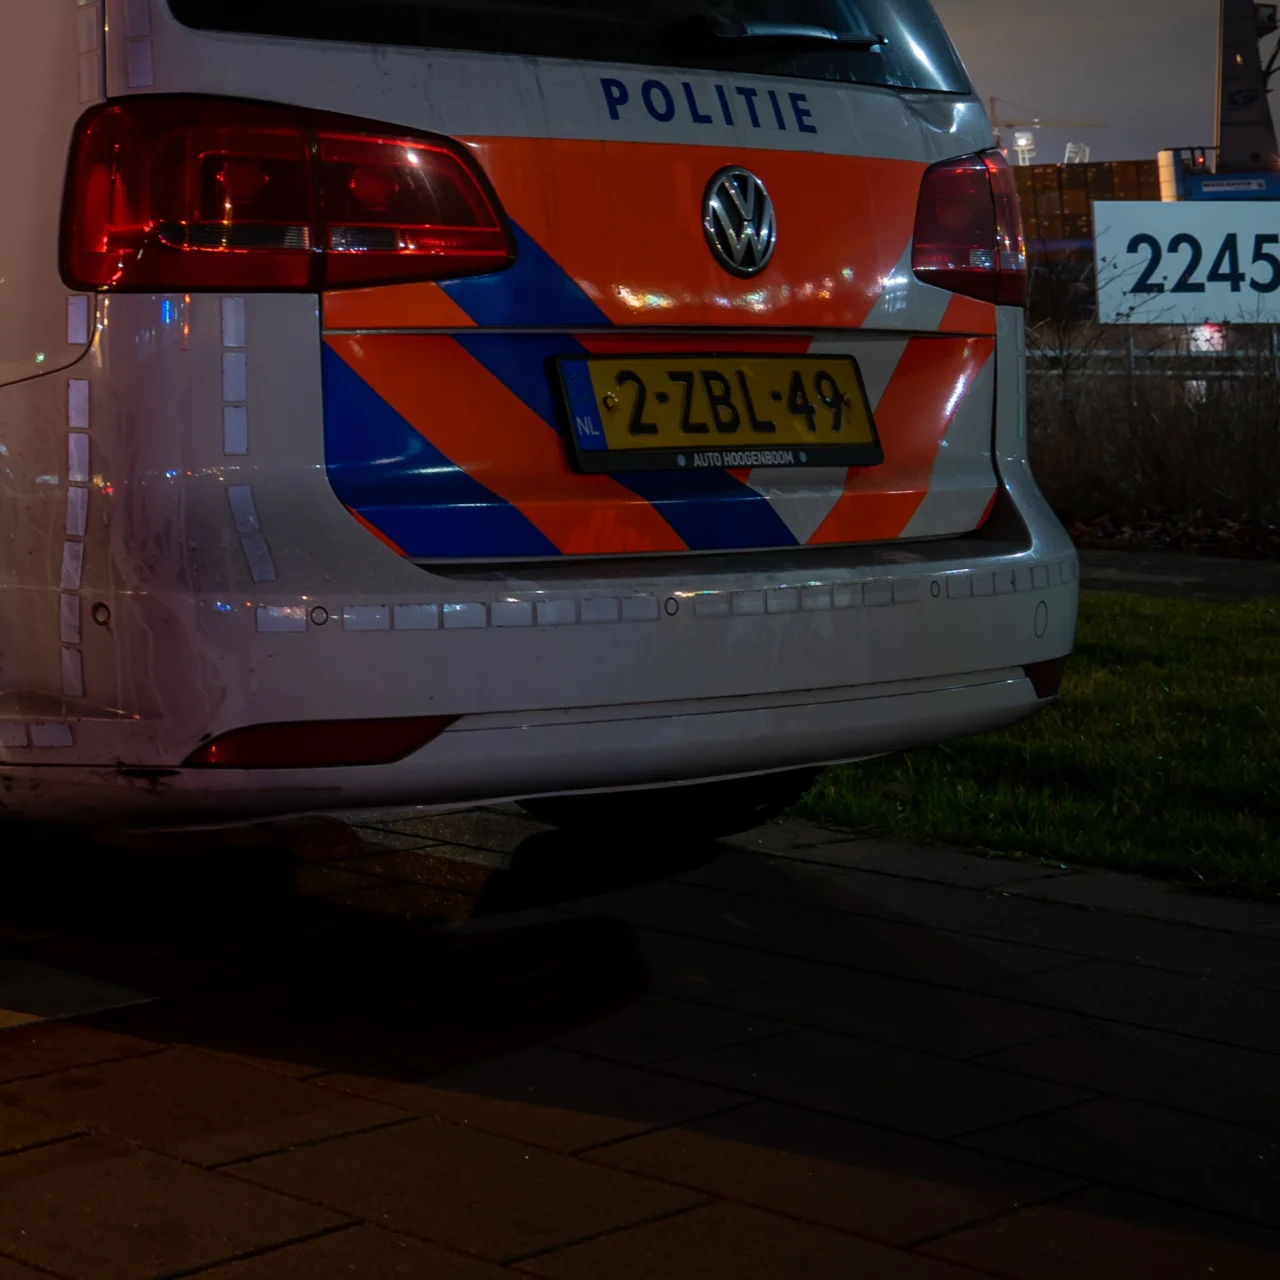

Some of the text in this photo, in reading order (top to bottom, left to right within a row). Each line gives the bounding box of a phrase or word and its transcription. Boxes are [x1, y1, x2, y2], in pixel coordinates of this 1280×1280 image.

[600, 78, 818, 134] POLITIE
[1126, 232, 1280, 294] 2245
[575, 415, 600, 436] NL
[616, 370, 842, 436] 2-ZBL-49
[693, 450, 795, 467] AUTO HOOGENBOOM
